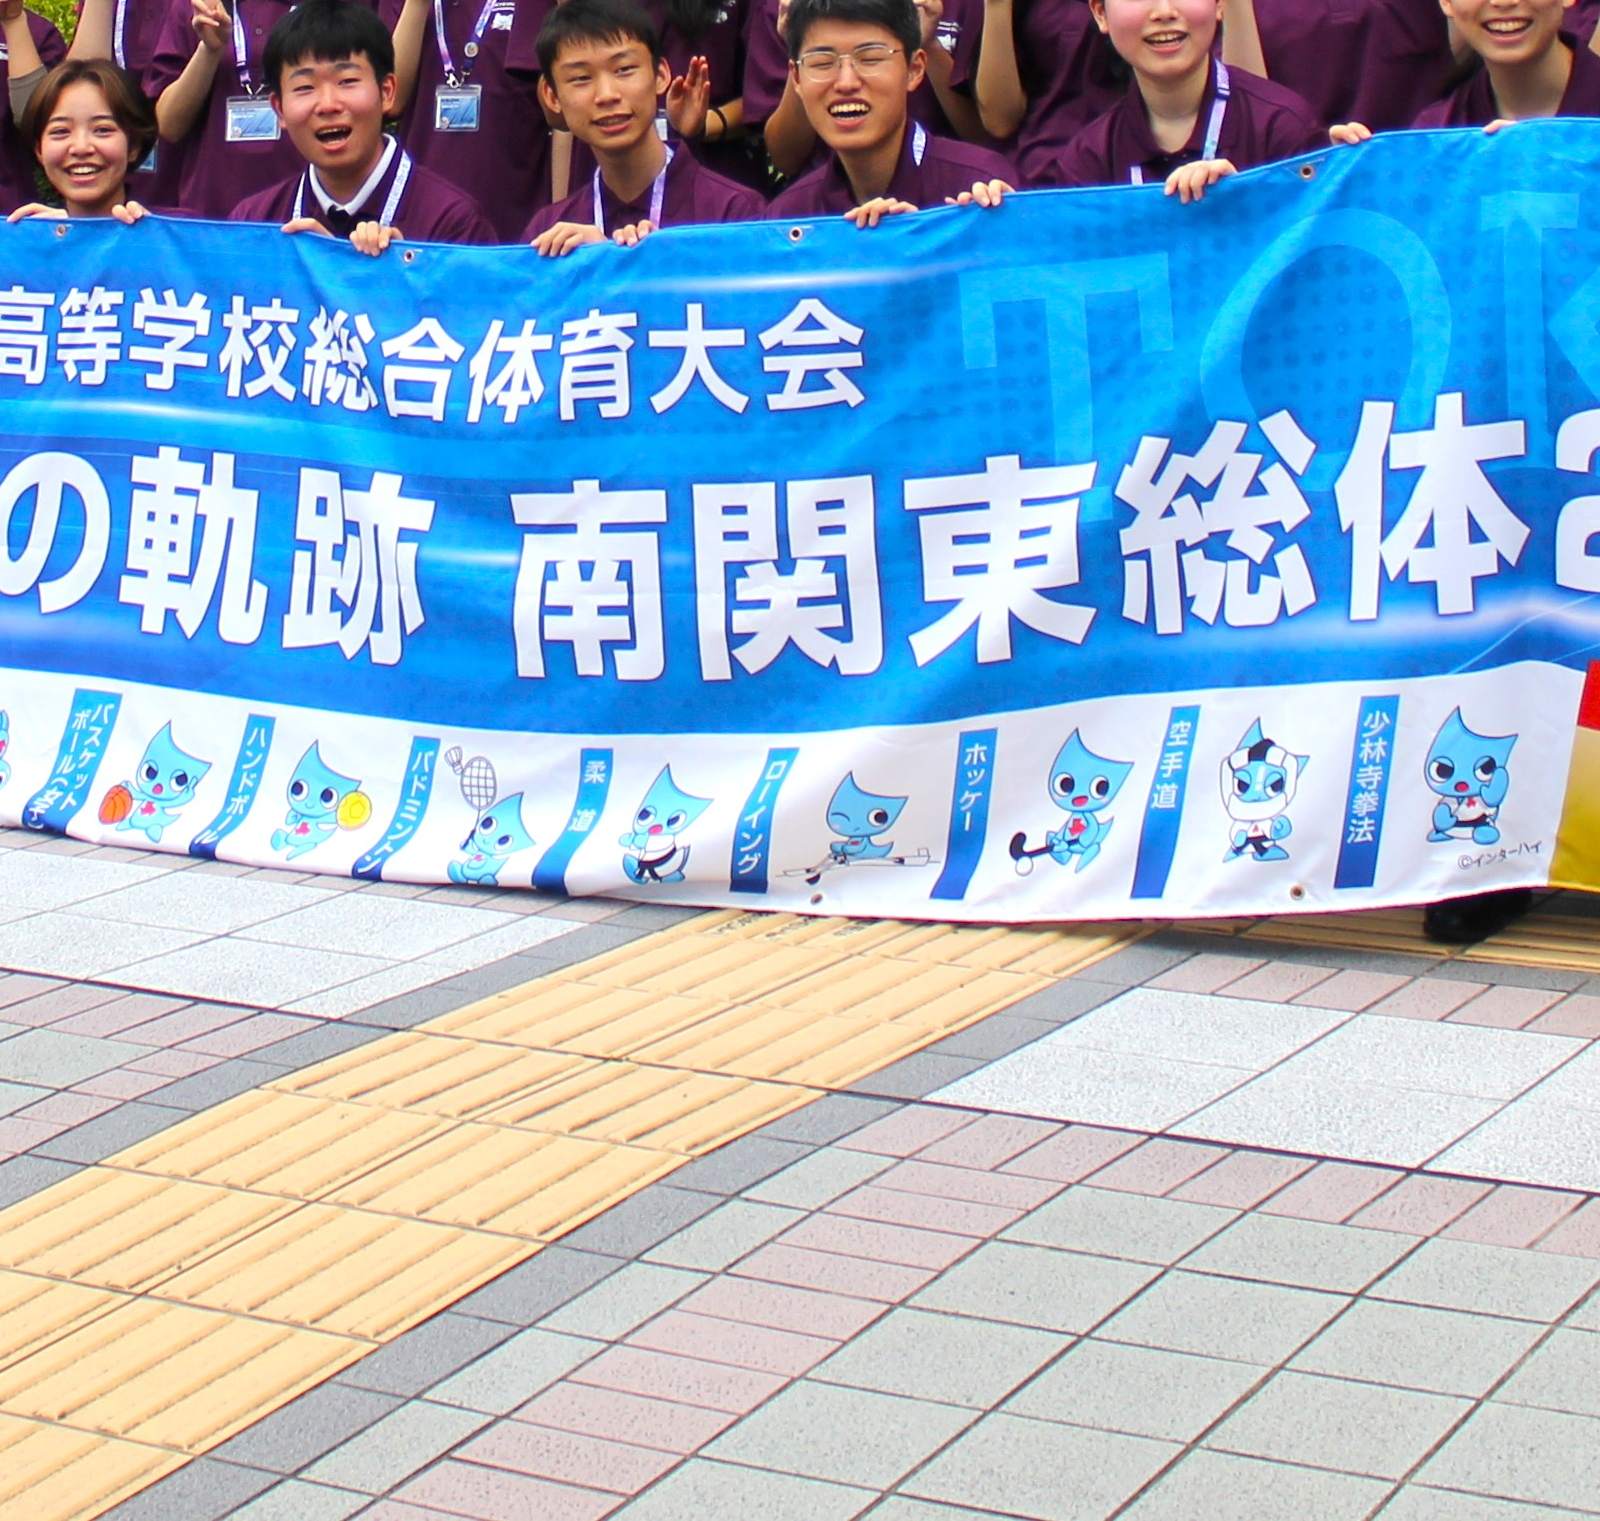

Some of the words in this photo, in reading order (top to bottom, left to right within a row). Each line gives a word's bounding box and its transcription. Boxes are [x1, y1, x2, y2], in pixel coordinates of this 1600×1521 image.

[568, 760, 607, 833] 柔道
[958, 743, 989, 831] ホッケー
[1151, 720, 1192, 810] 空手道
[1346, 710, 1391, 843] 少林寺拳法
[737, 759, 786, 875] ローイング
